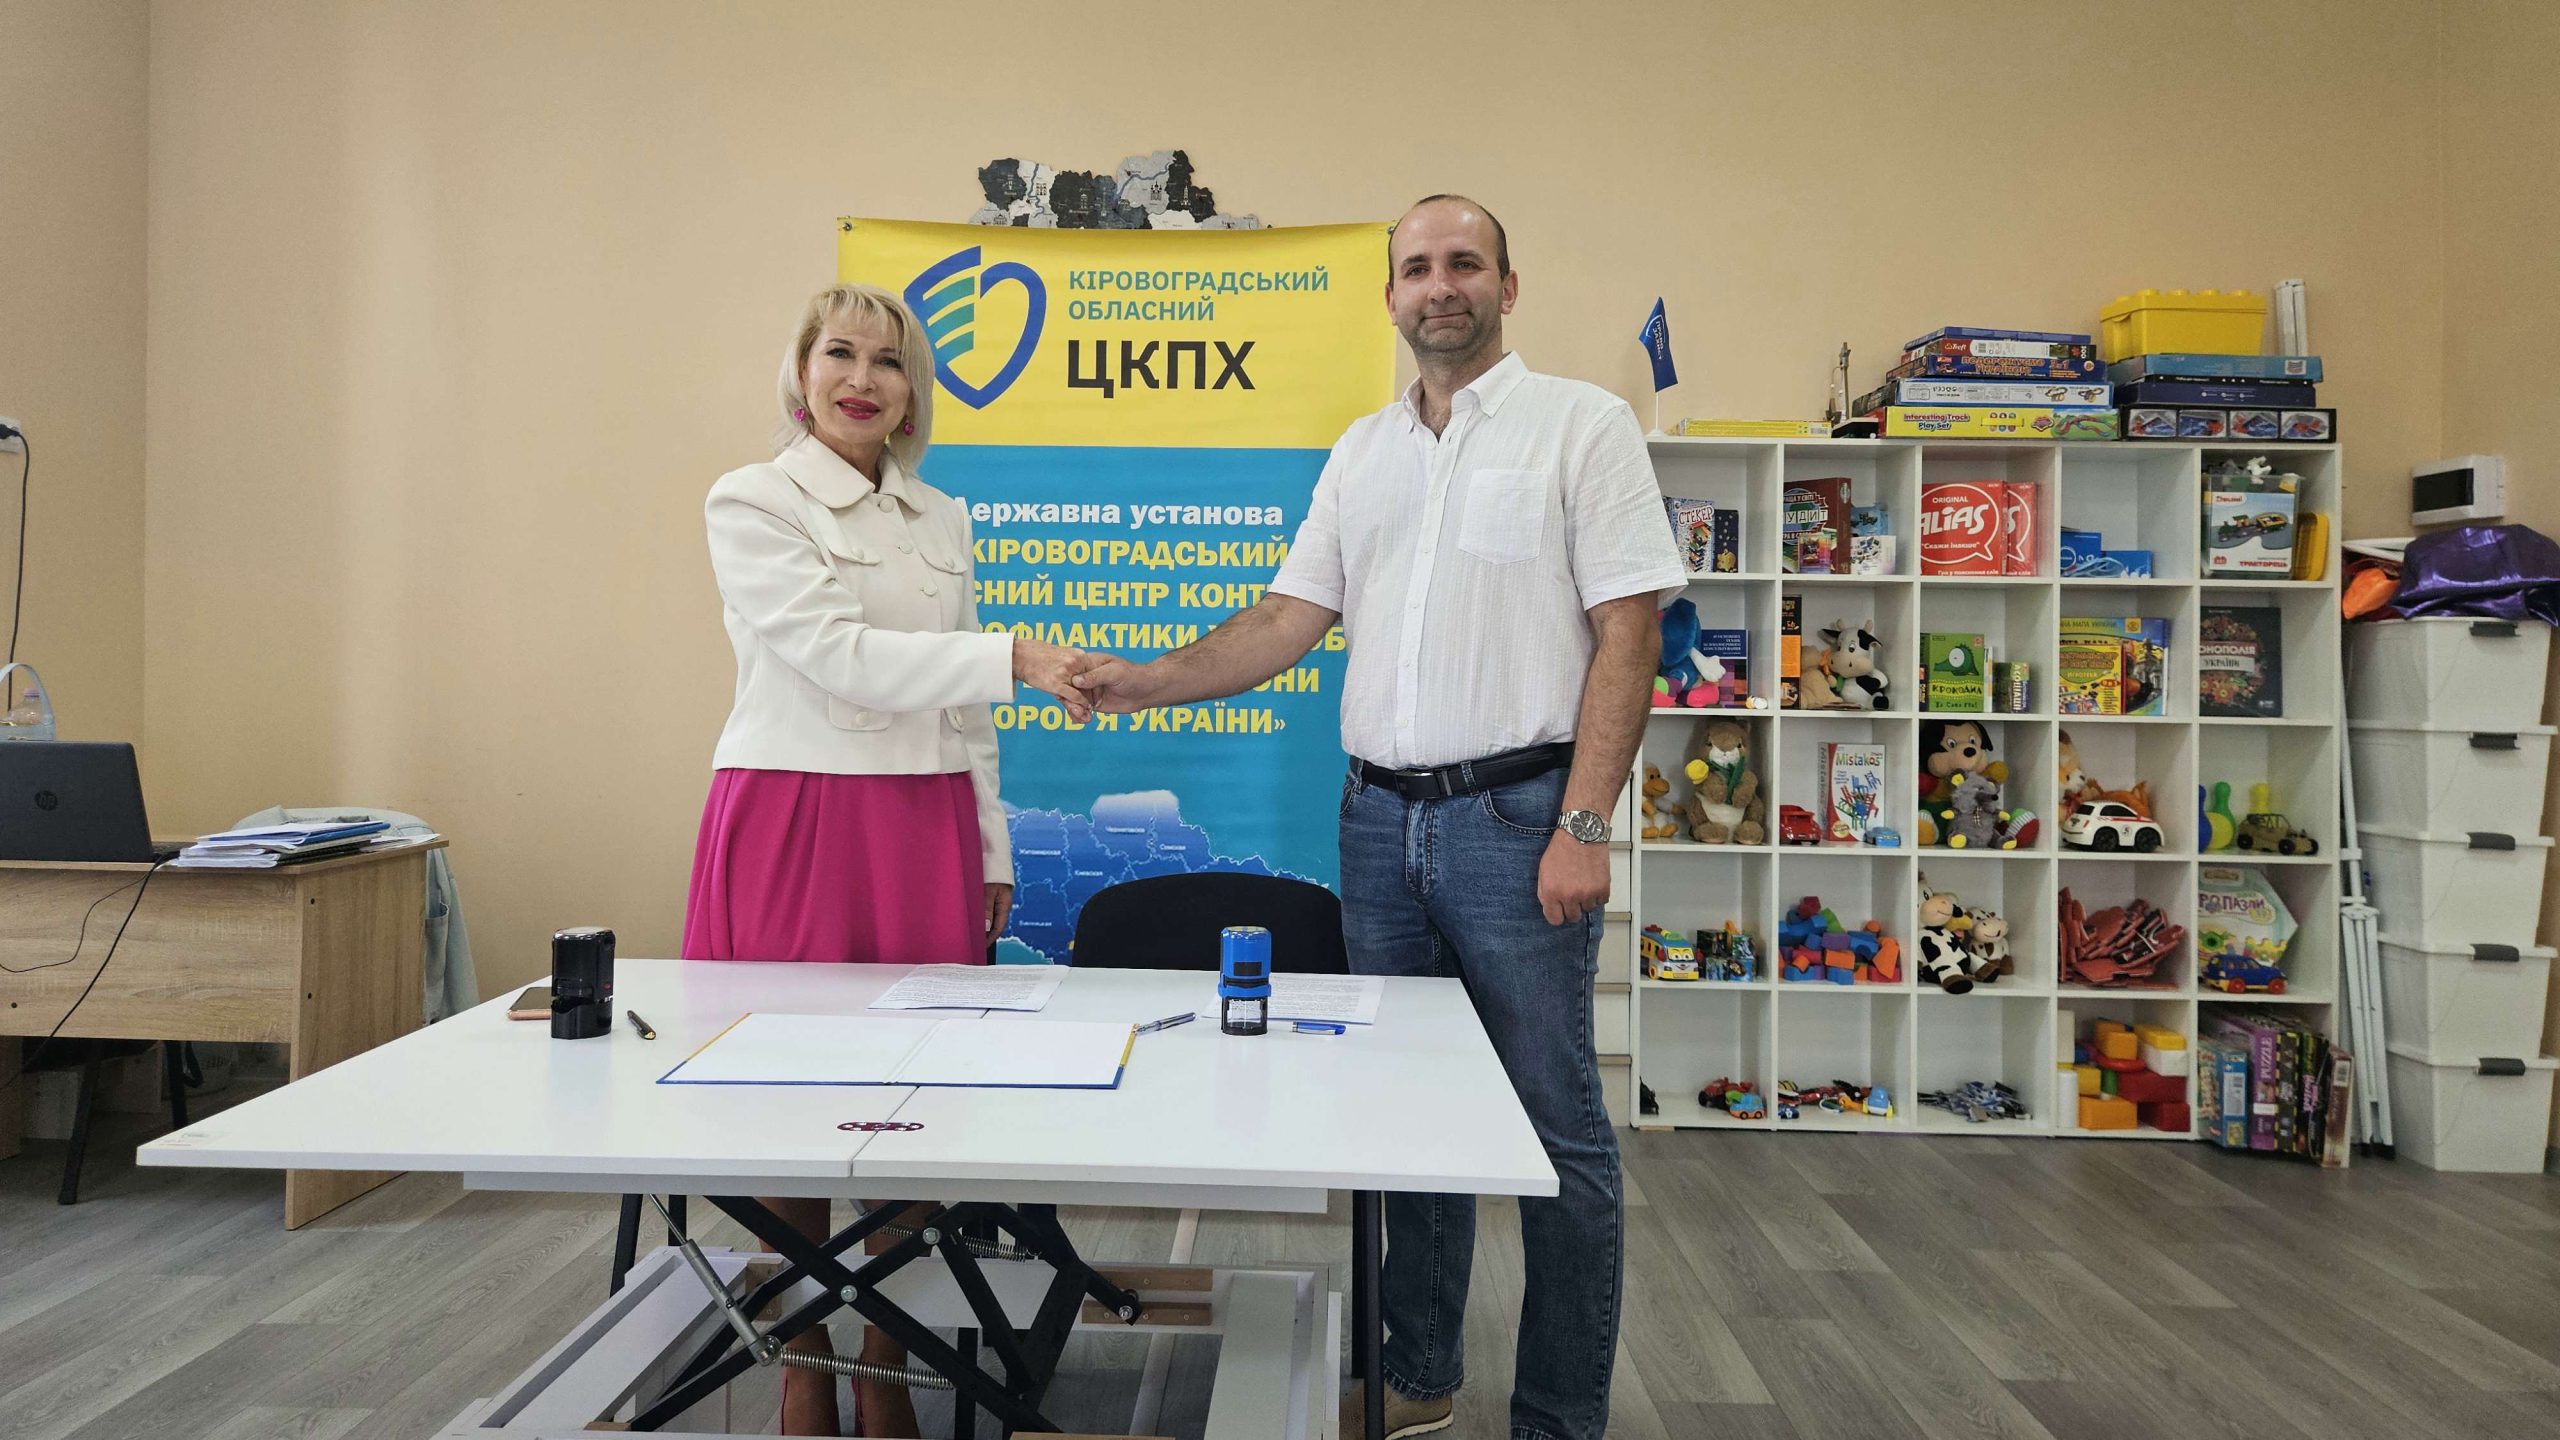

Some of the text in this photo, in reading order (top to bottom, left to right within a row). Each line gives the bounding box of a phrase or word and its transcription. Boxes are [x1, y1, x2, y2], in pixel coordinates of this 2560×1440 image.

[1068, 265, 1329, 294] КІРОВОГРАДСЬКИЙ
[1068, 296, 1215, 321] ОБЛАСНИЙ
[1067, 339, 1256, 399] ЦКПХ
[1904, 413, 1970, 422] Interesting Track
[1918, 422, 1935, 431] Play
[1130, 503, 1284, 529] установа
[1678, 506, 1713, 525] СТЕКЕР
[1787, 510, 1827, 523] УДИТ
[1064, 581, 1170, 611] ЦЕНТР
[1179, 583, 1271, 608] КОНТ
[2199, 645, 2256, 655] ОНОПОЛІЯ
[1932, 684, 1982, 695] КРОКОДИЛ
[1836, 753, 1881, 767] Mistakos
[2260, 1036, 2273, 1079] PUZZLE
